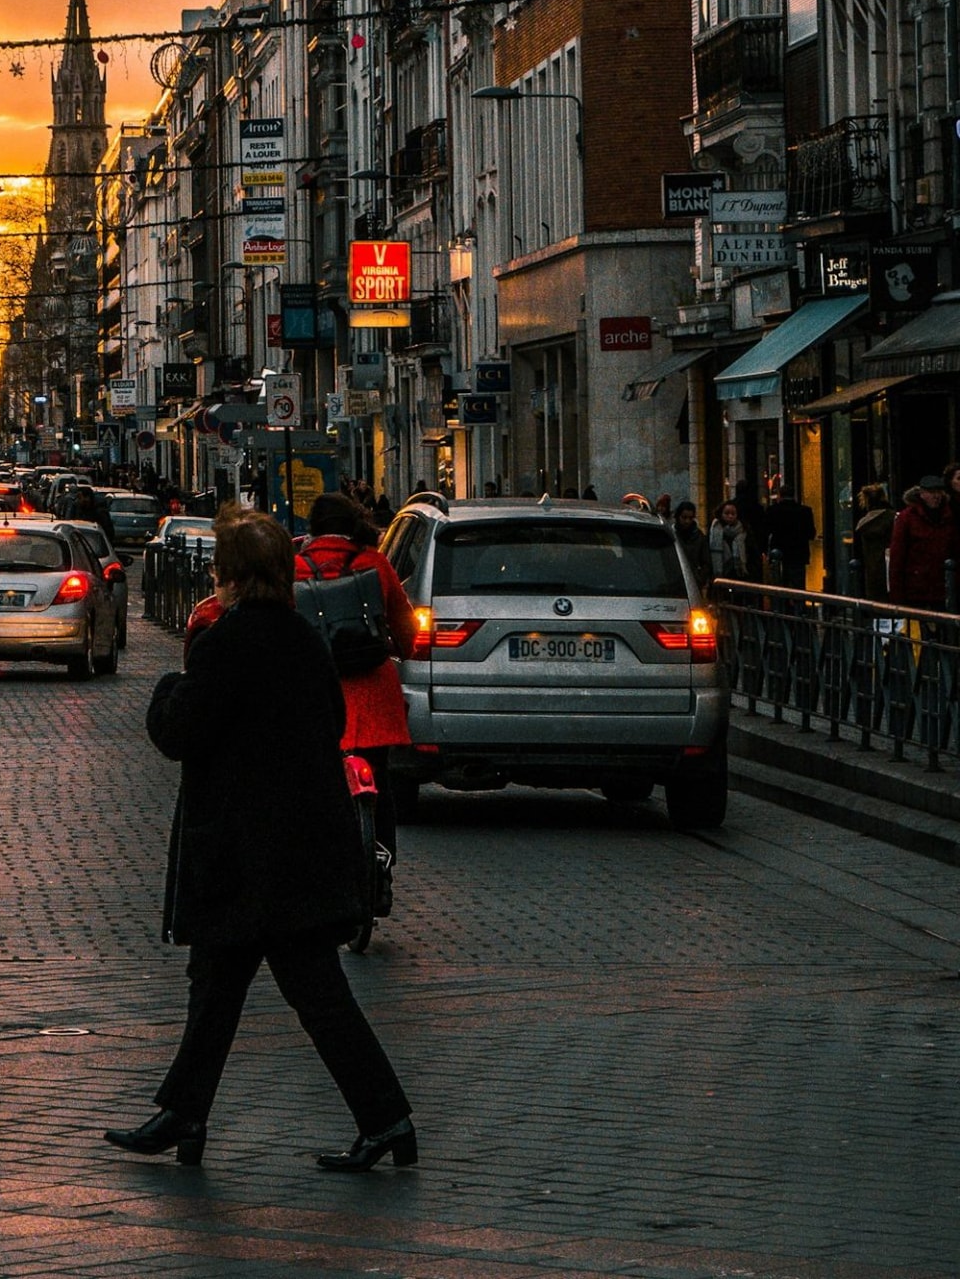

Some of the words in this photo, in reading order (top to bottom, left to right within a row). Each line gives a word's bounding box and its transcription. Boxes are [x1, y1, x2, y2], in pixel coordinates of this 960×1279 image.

[243, 120, 281, 133] Arrow
[668, 186, 711, 199] MONT
[669, 199, 710, 212] BLANC
[739, 198, 783, 215] Dupont
[721, 239, 786, 250] ALFRED
[873, 246, 903, 254] PANDA
[905, 246, 932, 254] SUSHI
[374, 244, 387, 266] V
[717, 251, 793, 262] DUNHILL
[361, 266, 399, 275] VIRGINIA
[827, 257, 848, 272] Jeff
[838, 270, 847, 278] de
[355, 276, 405, 300] SPORT
[827, 274, 867, 289] Bruges
[604, 329, 649, 345] arche
[478, 369, 504, 379] LCL
[464, 401, 491, 411] LCL
[521, 639, 603, 658] DC-900-CD
